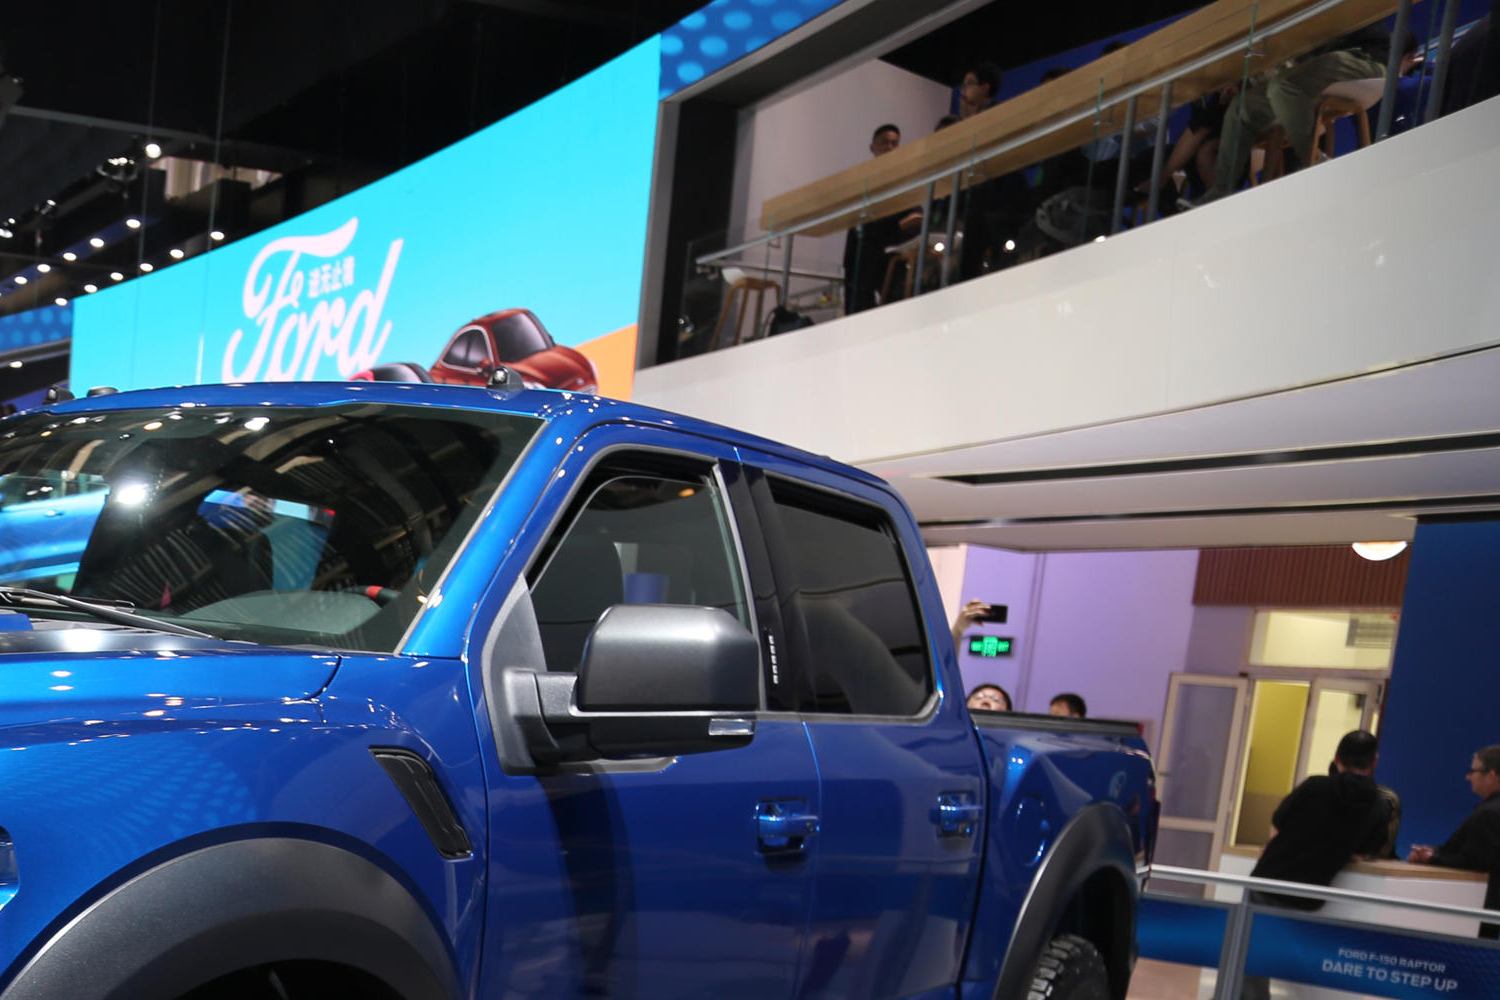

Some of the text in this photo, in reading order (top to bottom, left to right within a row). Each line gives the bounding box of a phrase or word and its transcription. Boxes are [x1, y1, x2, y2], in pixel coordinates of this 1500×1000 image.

[222, 216, 404, 384] Ford
[1322, 959, 1458, 992] DARE TO STEP UP
[1338, 948, 1367, 961] FORD
[1399, 957, 1446, 973] RAPTOR
